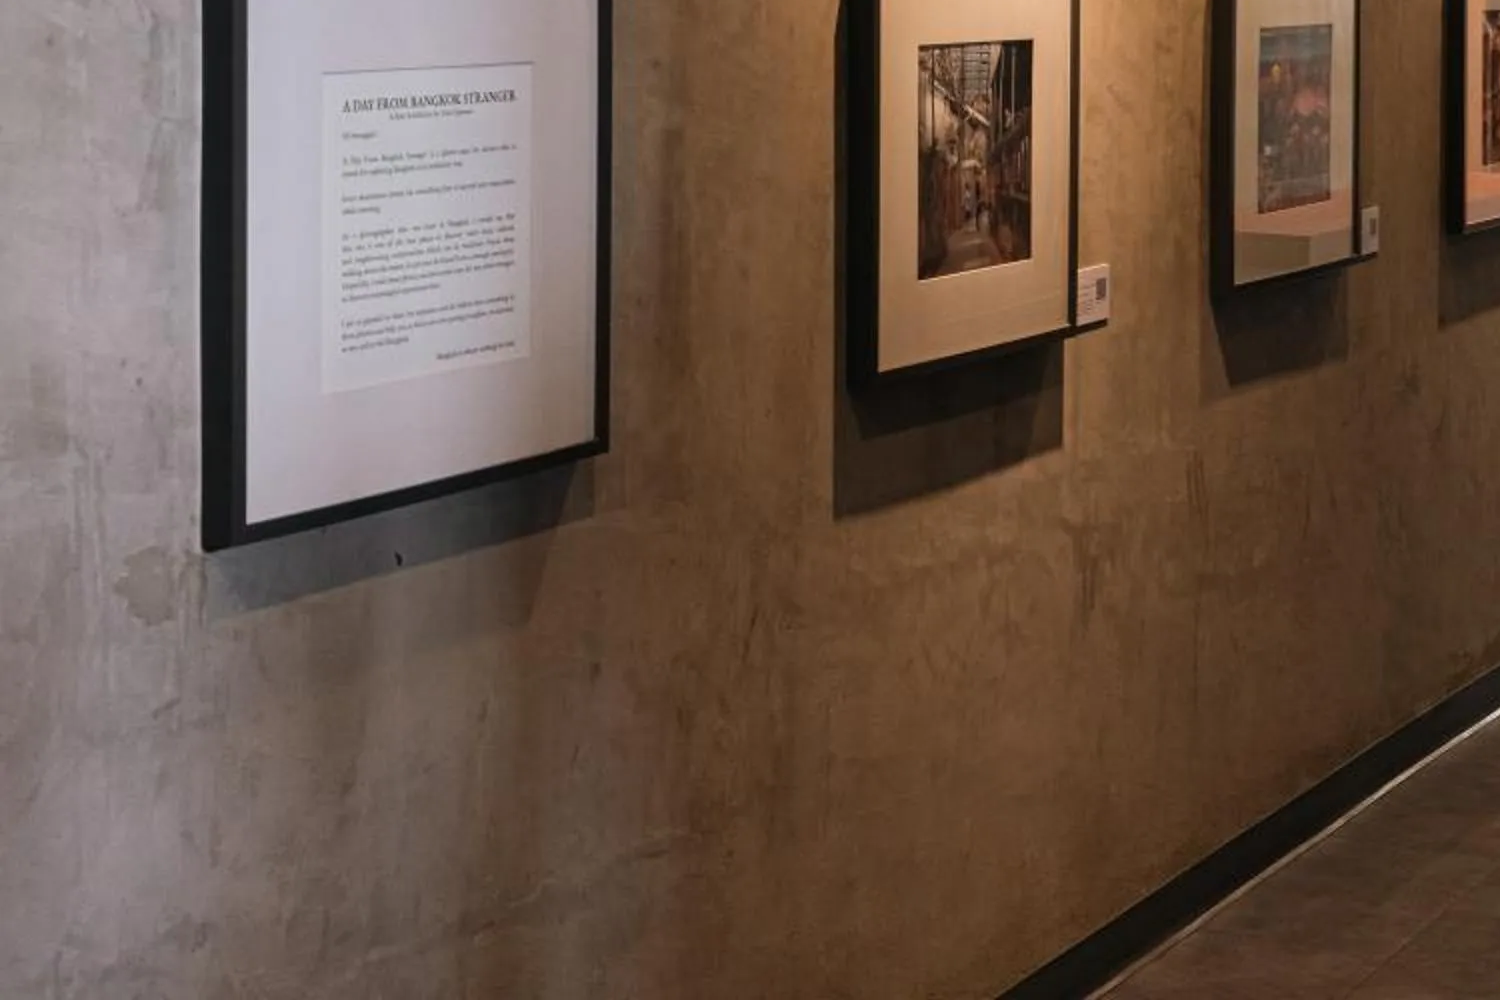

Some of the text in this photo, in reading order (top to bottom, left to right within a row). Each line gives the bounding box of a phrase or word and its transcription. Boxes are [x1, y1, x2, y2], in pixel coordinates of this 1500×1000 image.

[343, 90, 517, 113] A DAY FROM BANGKOK STRANGER
